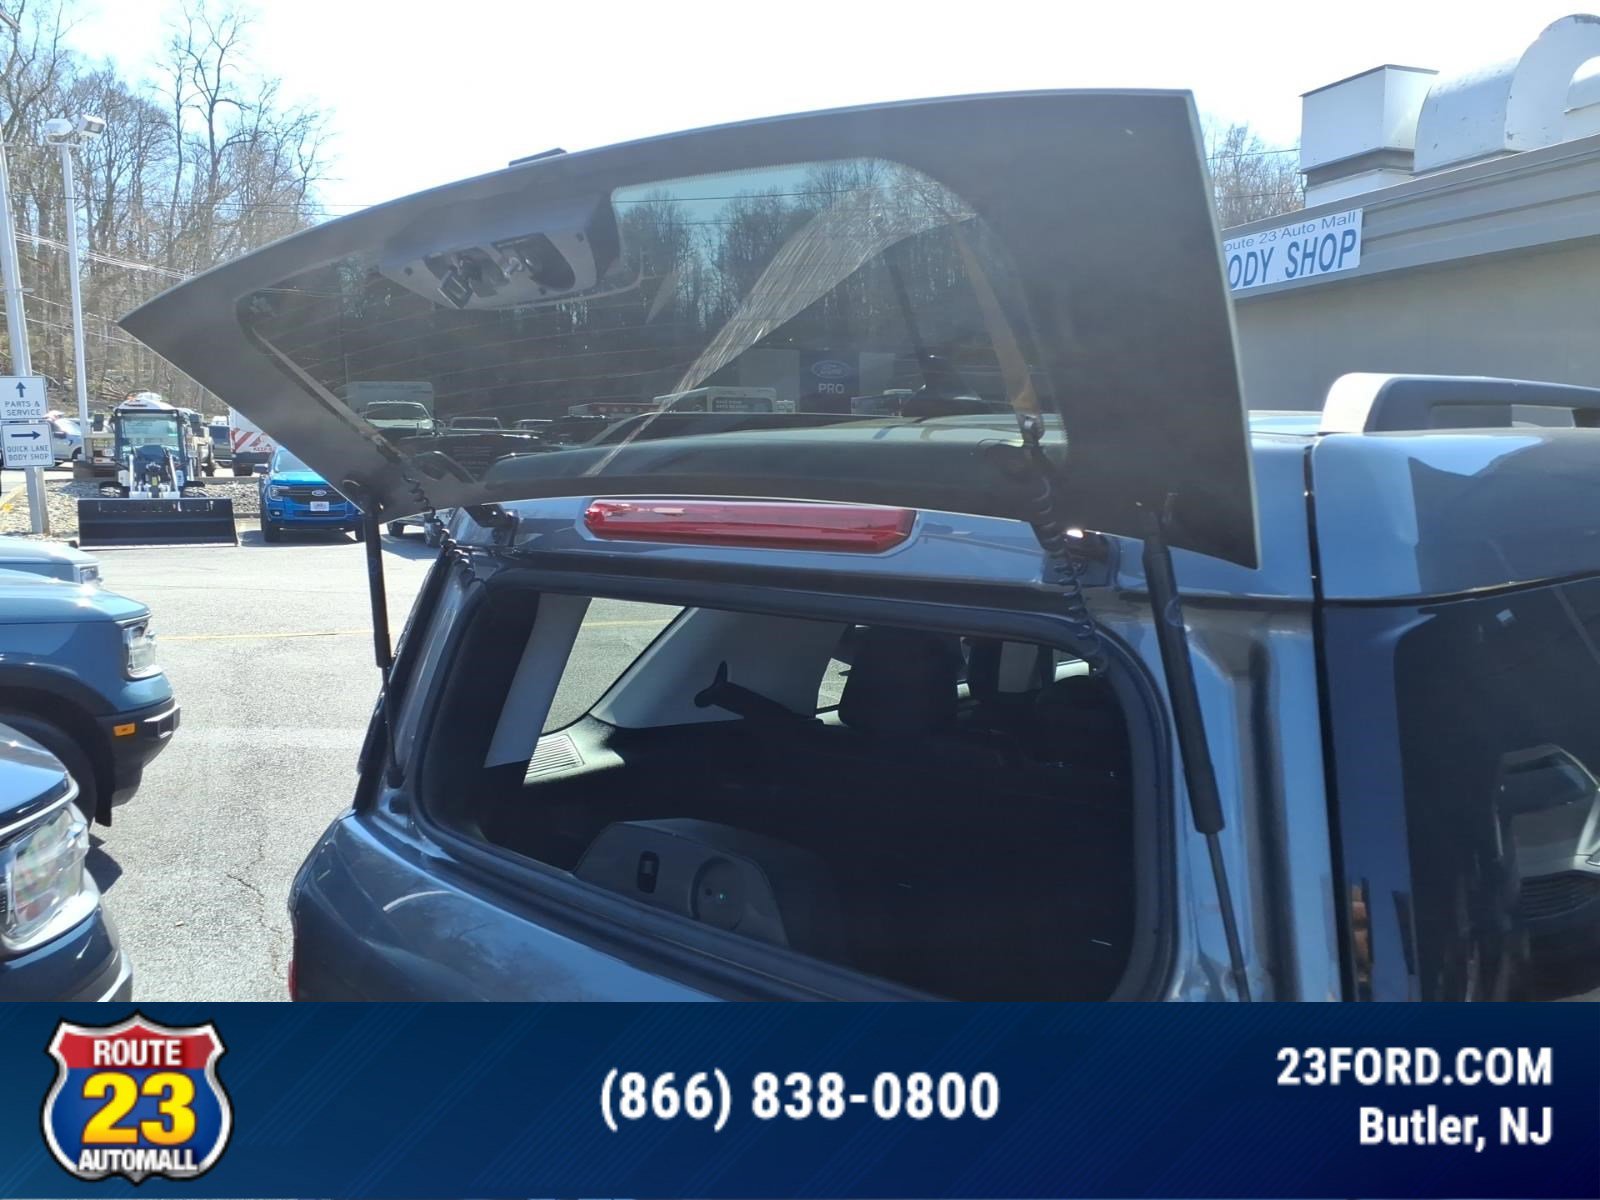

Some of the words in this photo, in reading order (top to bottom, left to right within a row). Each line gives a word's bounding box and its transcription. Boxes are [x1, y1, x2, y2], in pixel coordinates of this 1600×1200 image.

[1224, 237, 1255, 251] oute
[1258, 231, 1278, 245] 23
[1280, 222, 1316, 240] Auto
[1321, 211, 1356, 230] Mall
[1228, 247, 1275, 290] ODY
[1285, 228, 1357, 279] SHOP
[818, 383, 845, 394] PRO
[4, 400, 31, 408] PARTS
[7, 445, 28, 453] QUICK
[31, 444, 49, 452] LANE
[8, 453, 27, 461] BODY
[30, 453, 49, 461] SHOP
